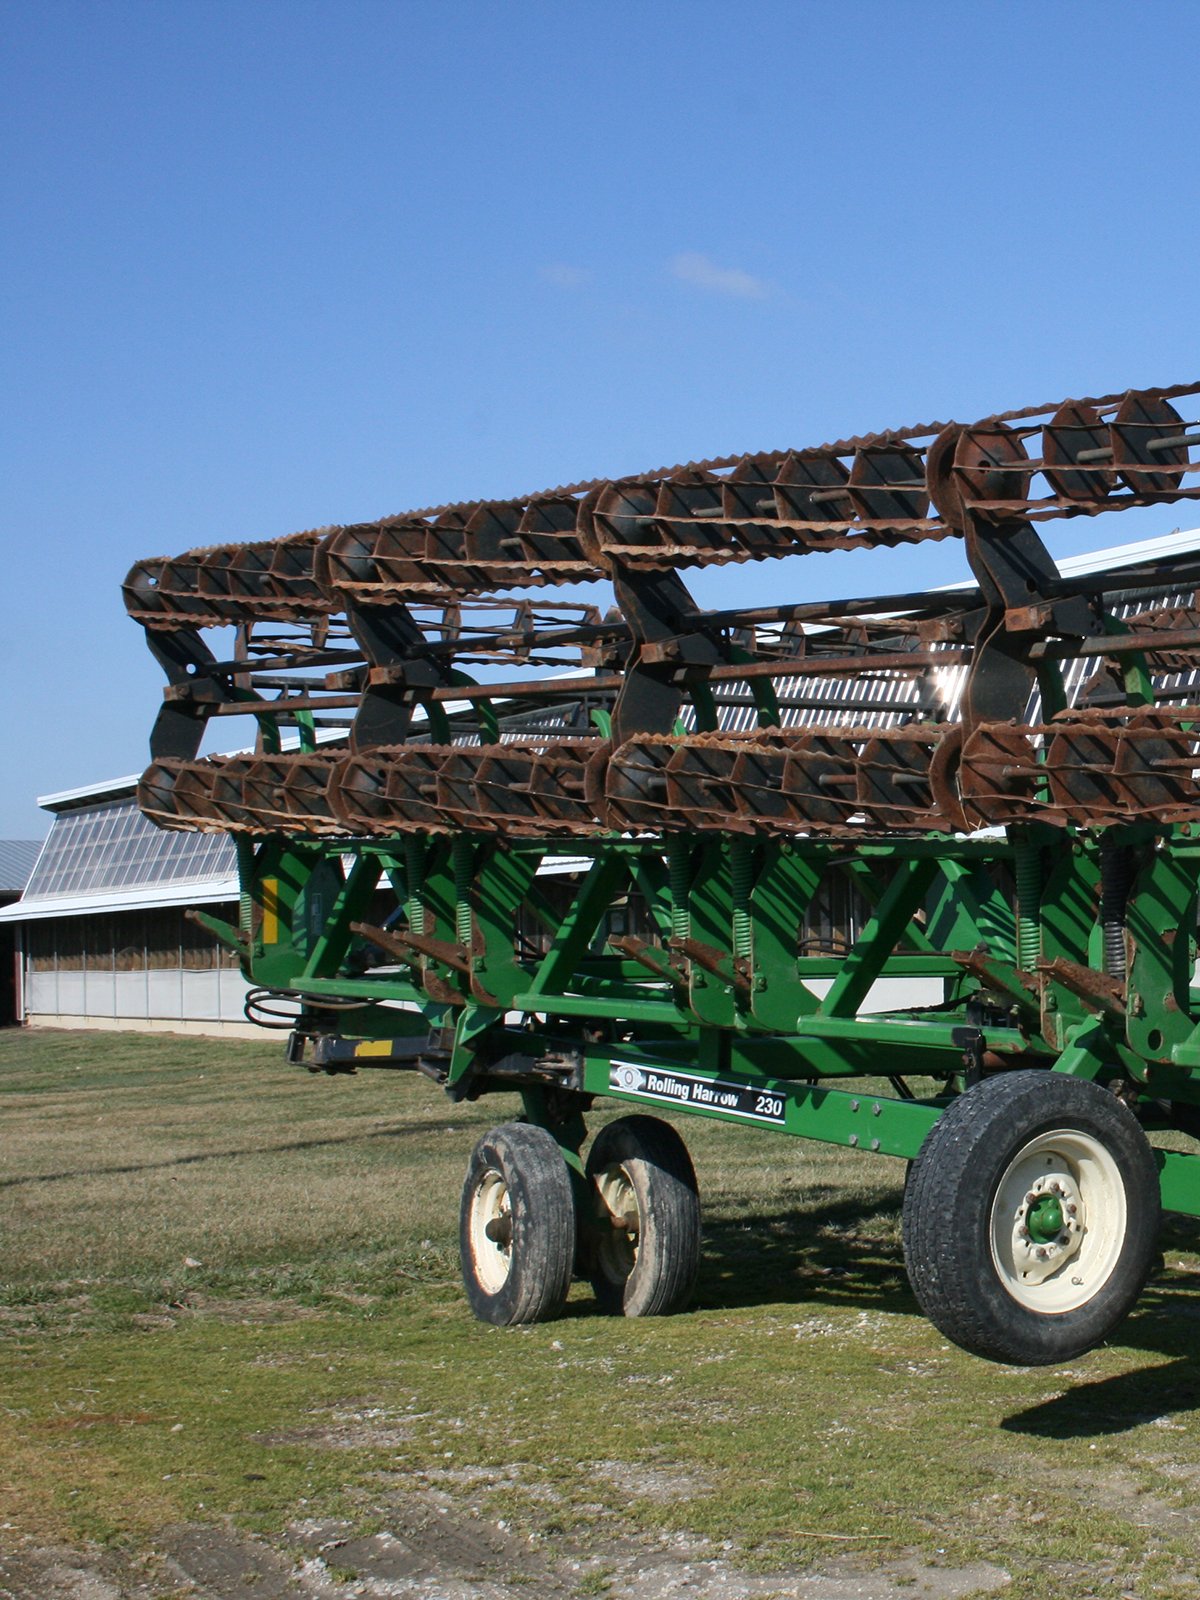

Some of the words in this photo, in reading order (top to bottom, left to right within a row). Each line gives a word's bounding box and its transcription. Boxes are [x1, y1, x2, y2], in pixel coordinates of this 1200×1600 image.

[647, 1074, 689, 1099] Rolling
[692, 1083, 739, 1107] Harrow
[755, 1095, 783, 1116] 230
